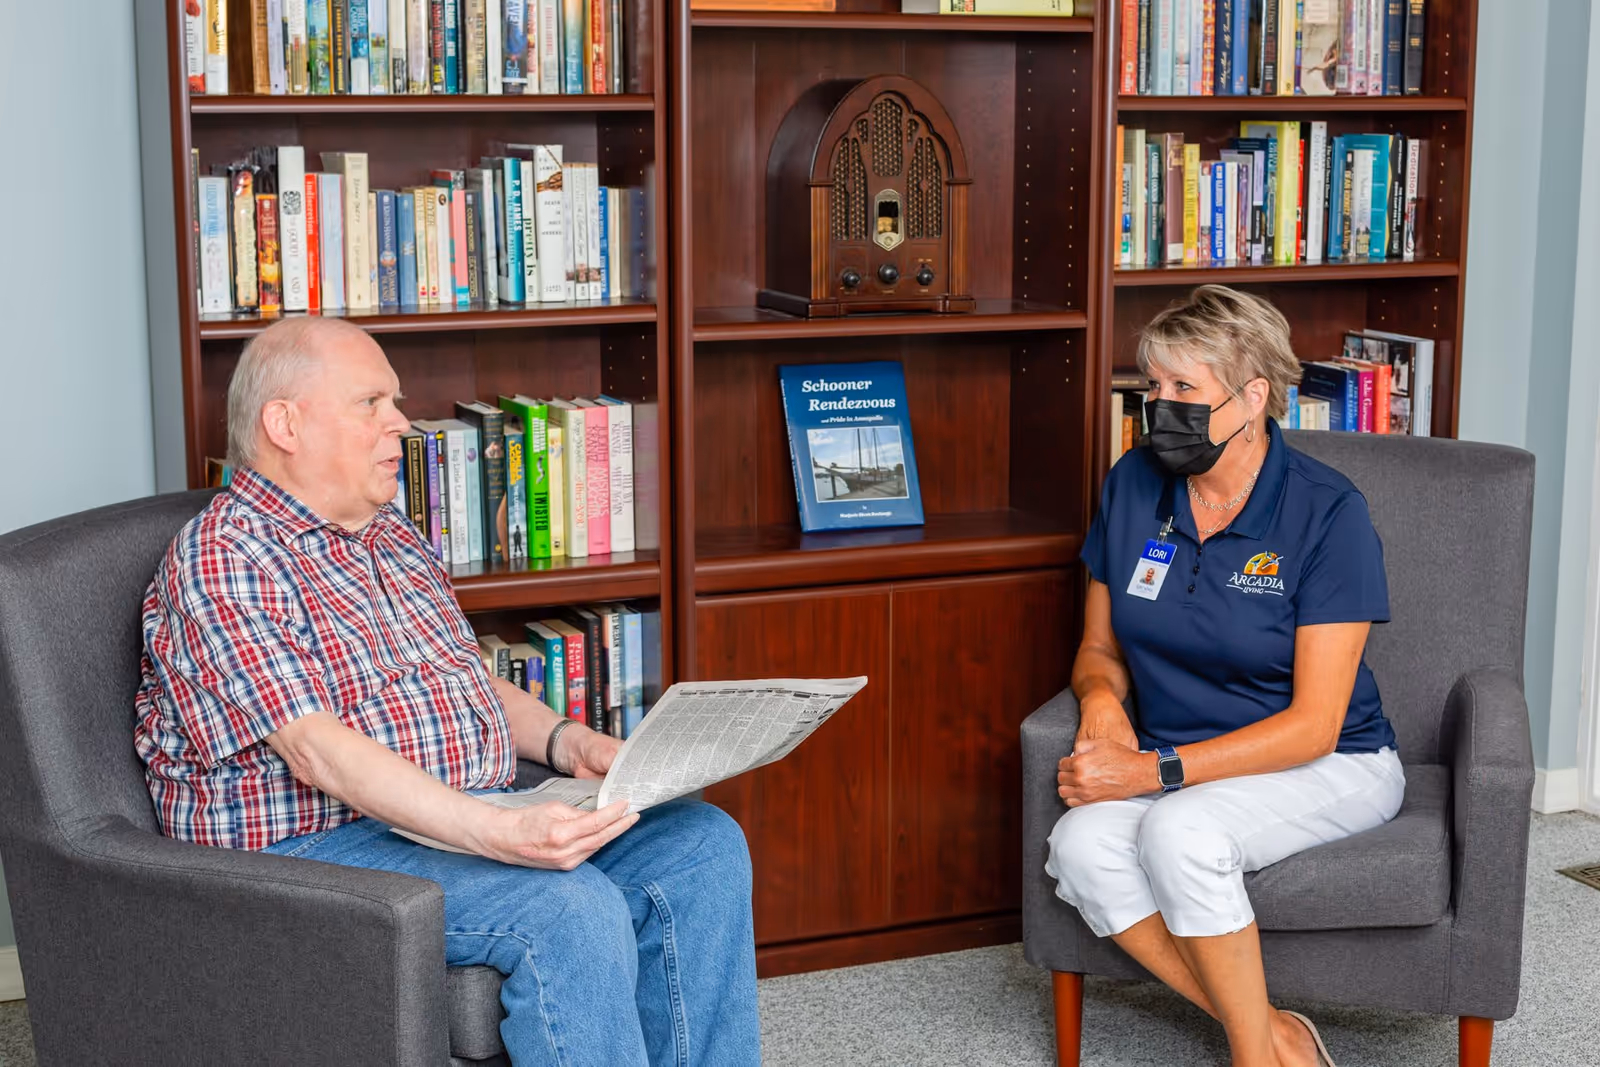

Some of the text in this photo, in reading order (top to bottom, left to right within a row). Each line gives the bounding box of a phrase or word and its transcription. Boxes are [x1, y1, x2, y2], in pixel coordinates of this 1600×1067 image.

[1344, 170, 1352, 189] DEAN
[1409, 144, 1418, 194] Dedication
[306, 181, 314, 234] indiscretion
[514, 202, 522, 232] JAMES
[524, 218, 536, 276] pretty is
[802, 378, 872, 392] Schooner
[808, 396, 896, 411] Rendezvous
[1362, 377, 1372, 433] Julie Garwood
[586, 425, 598, 462] KRANTZ
[598, 426, 608, 462] JUDITH
[610, 423, 622, 457] KRANTZ
[620, 424, 631, 454] JUDITH
[452, 449, 460, 462] Big
[514, 442, 522, 480] CAMILLA
[453, 463, 462, 484] Little
[575, 475, 584, 501] After
[588, 466, 599, 519] DAUGHTER
[613, 490, 623, 515] AGAIN
[534, 491, 548, 531] TWISTED
[1148, 547, 1167, 560] LORI
[1228, 572, 1284, 590] ARCADIA
[1242, 586, 1265, 594] LIVING
